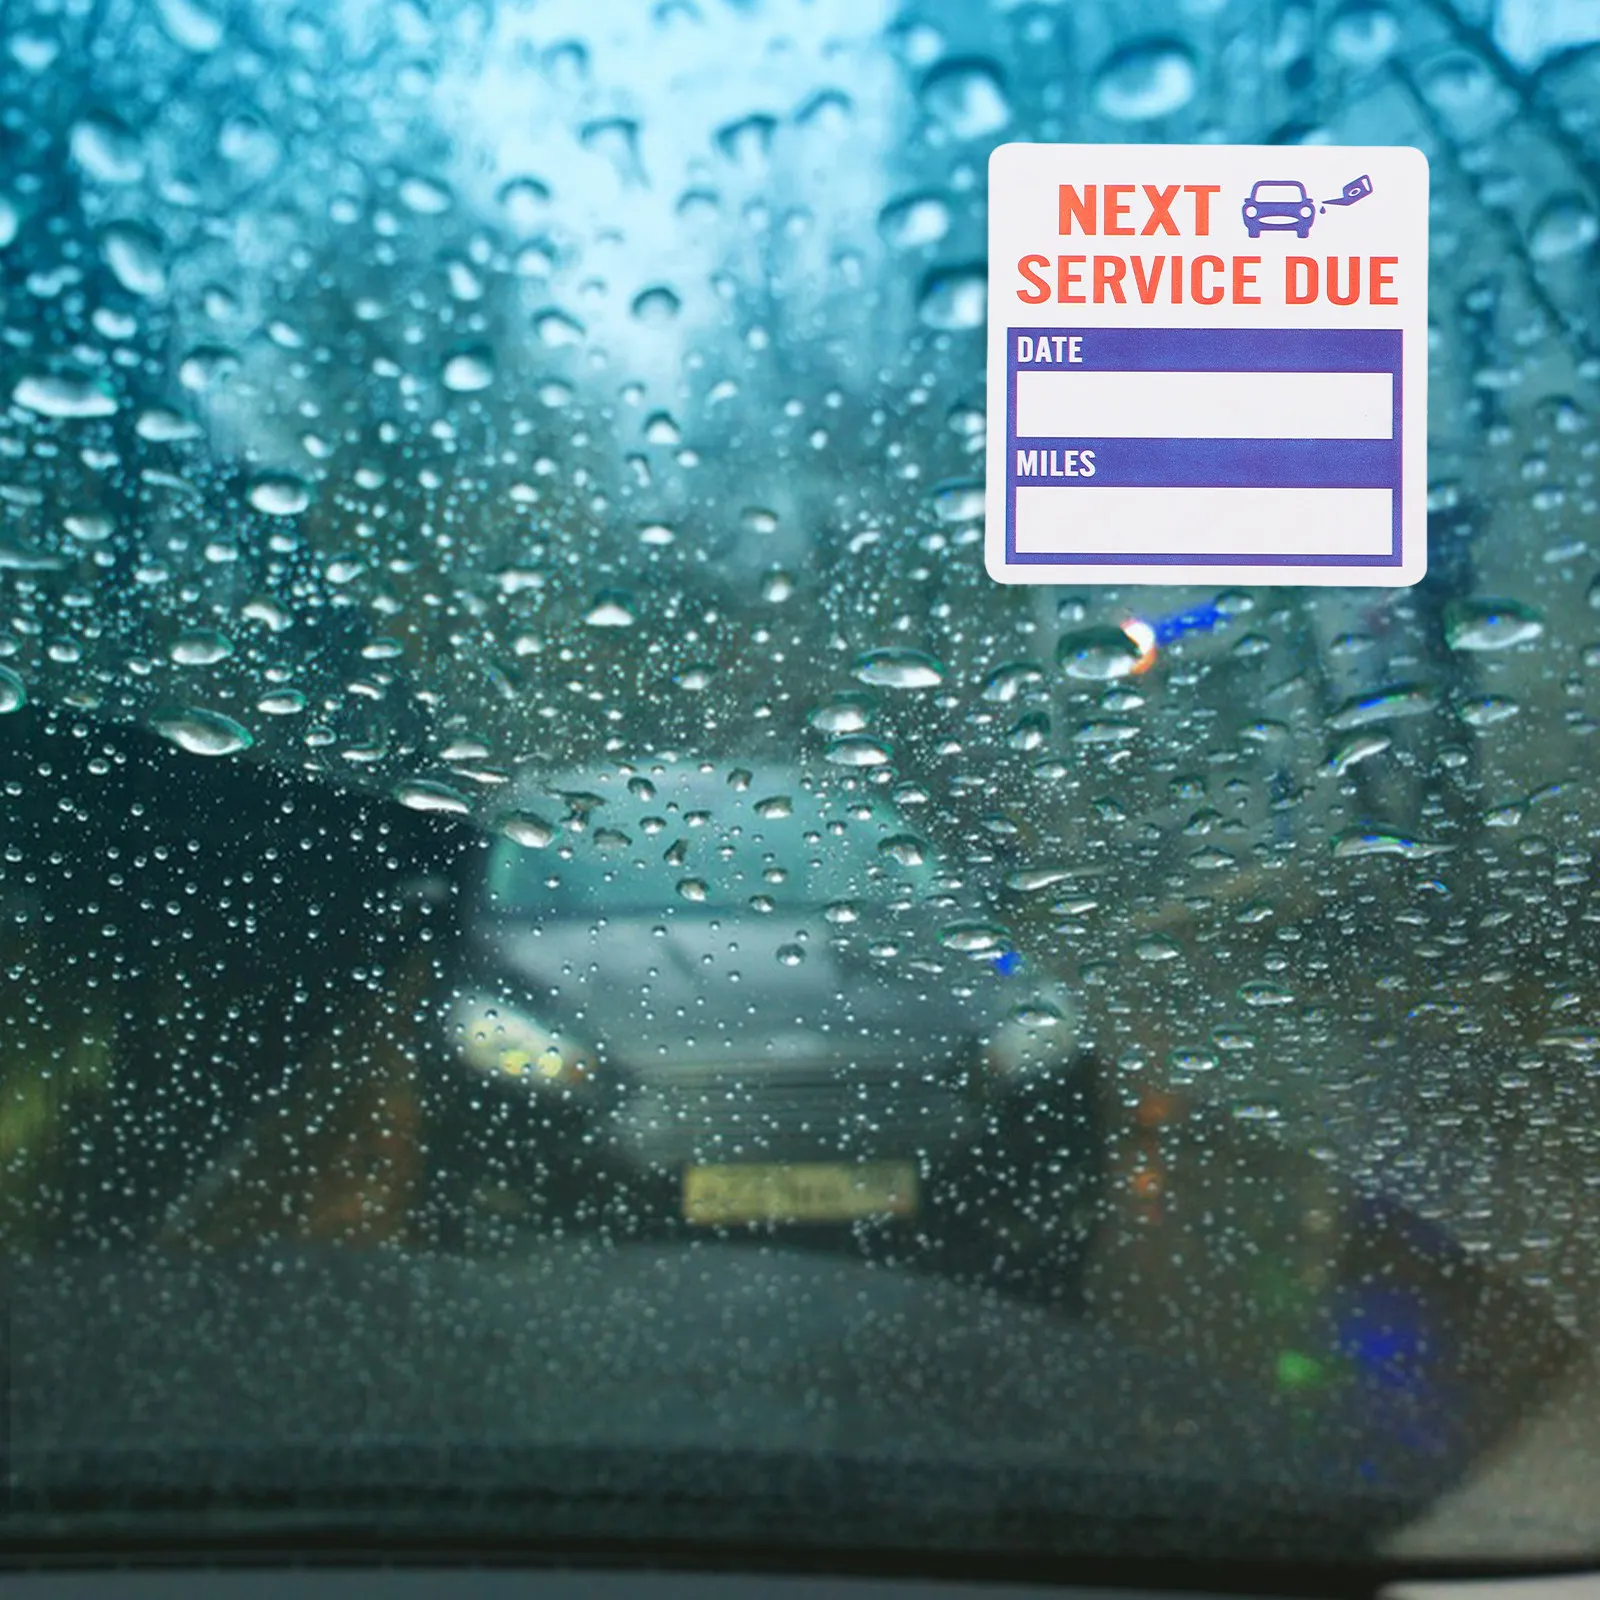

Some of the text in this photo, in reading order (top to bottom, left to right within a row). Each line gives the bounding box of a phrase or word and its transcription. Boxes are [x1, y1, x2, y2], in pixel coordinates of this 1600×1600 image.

[1058, 184, 1221, 236] NEXT
[1016, 254, 1399, 306] SERVICE DUE
[1017, 336, 1083, 363] DATE
[1016, 450, 1096, 477] MILES
